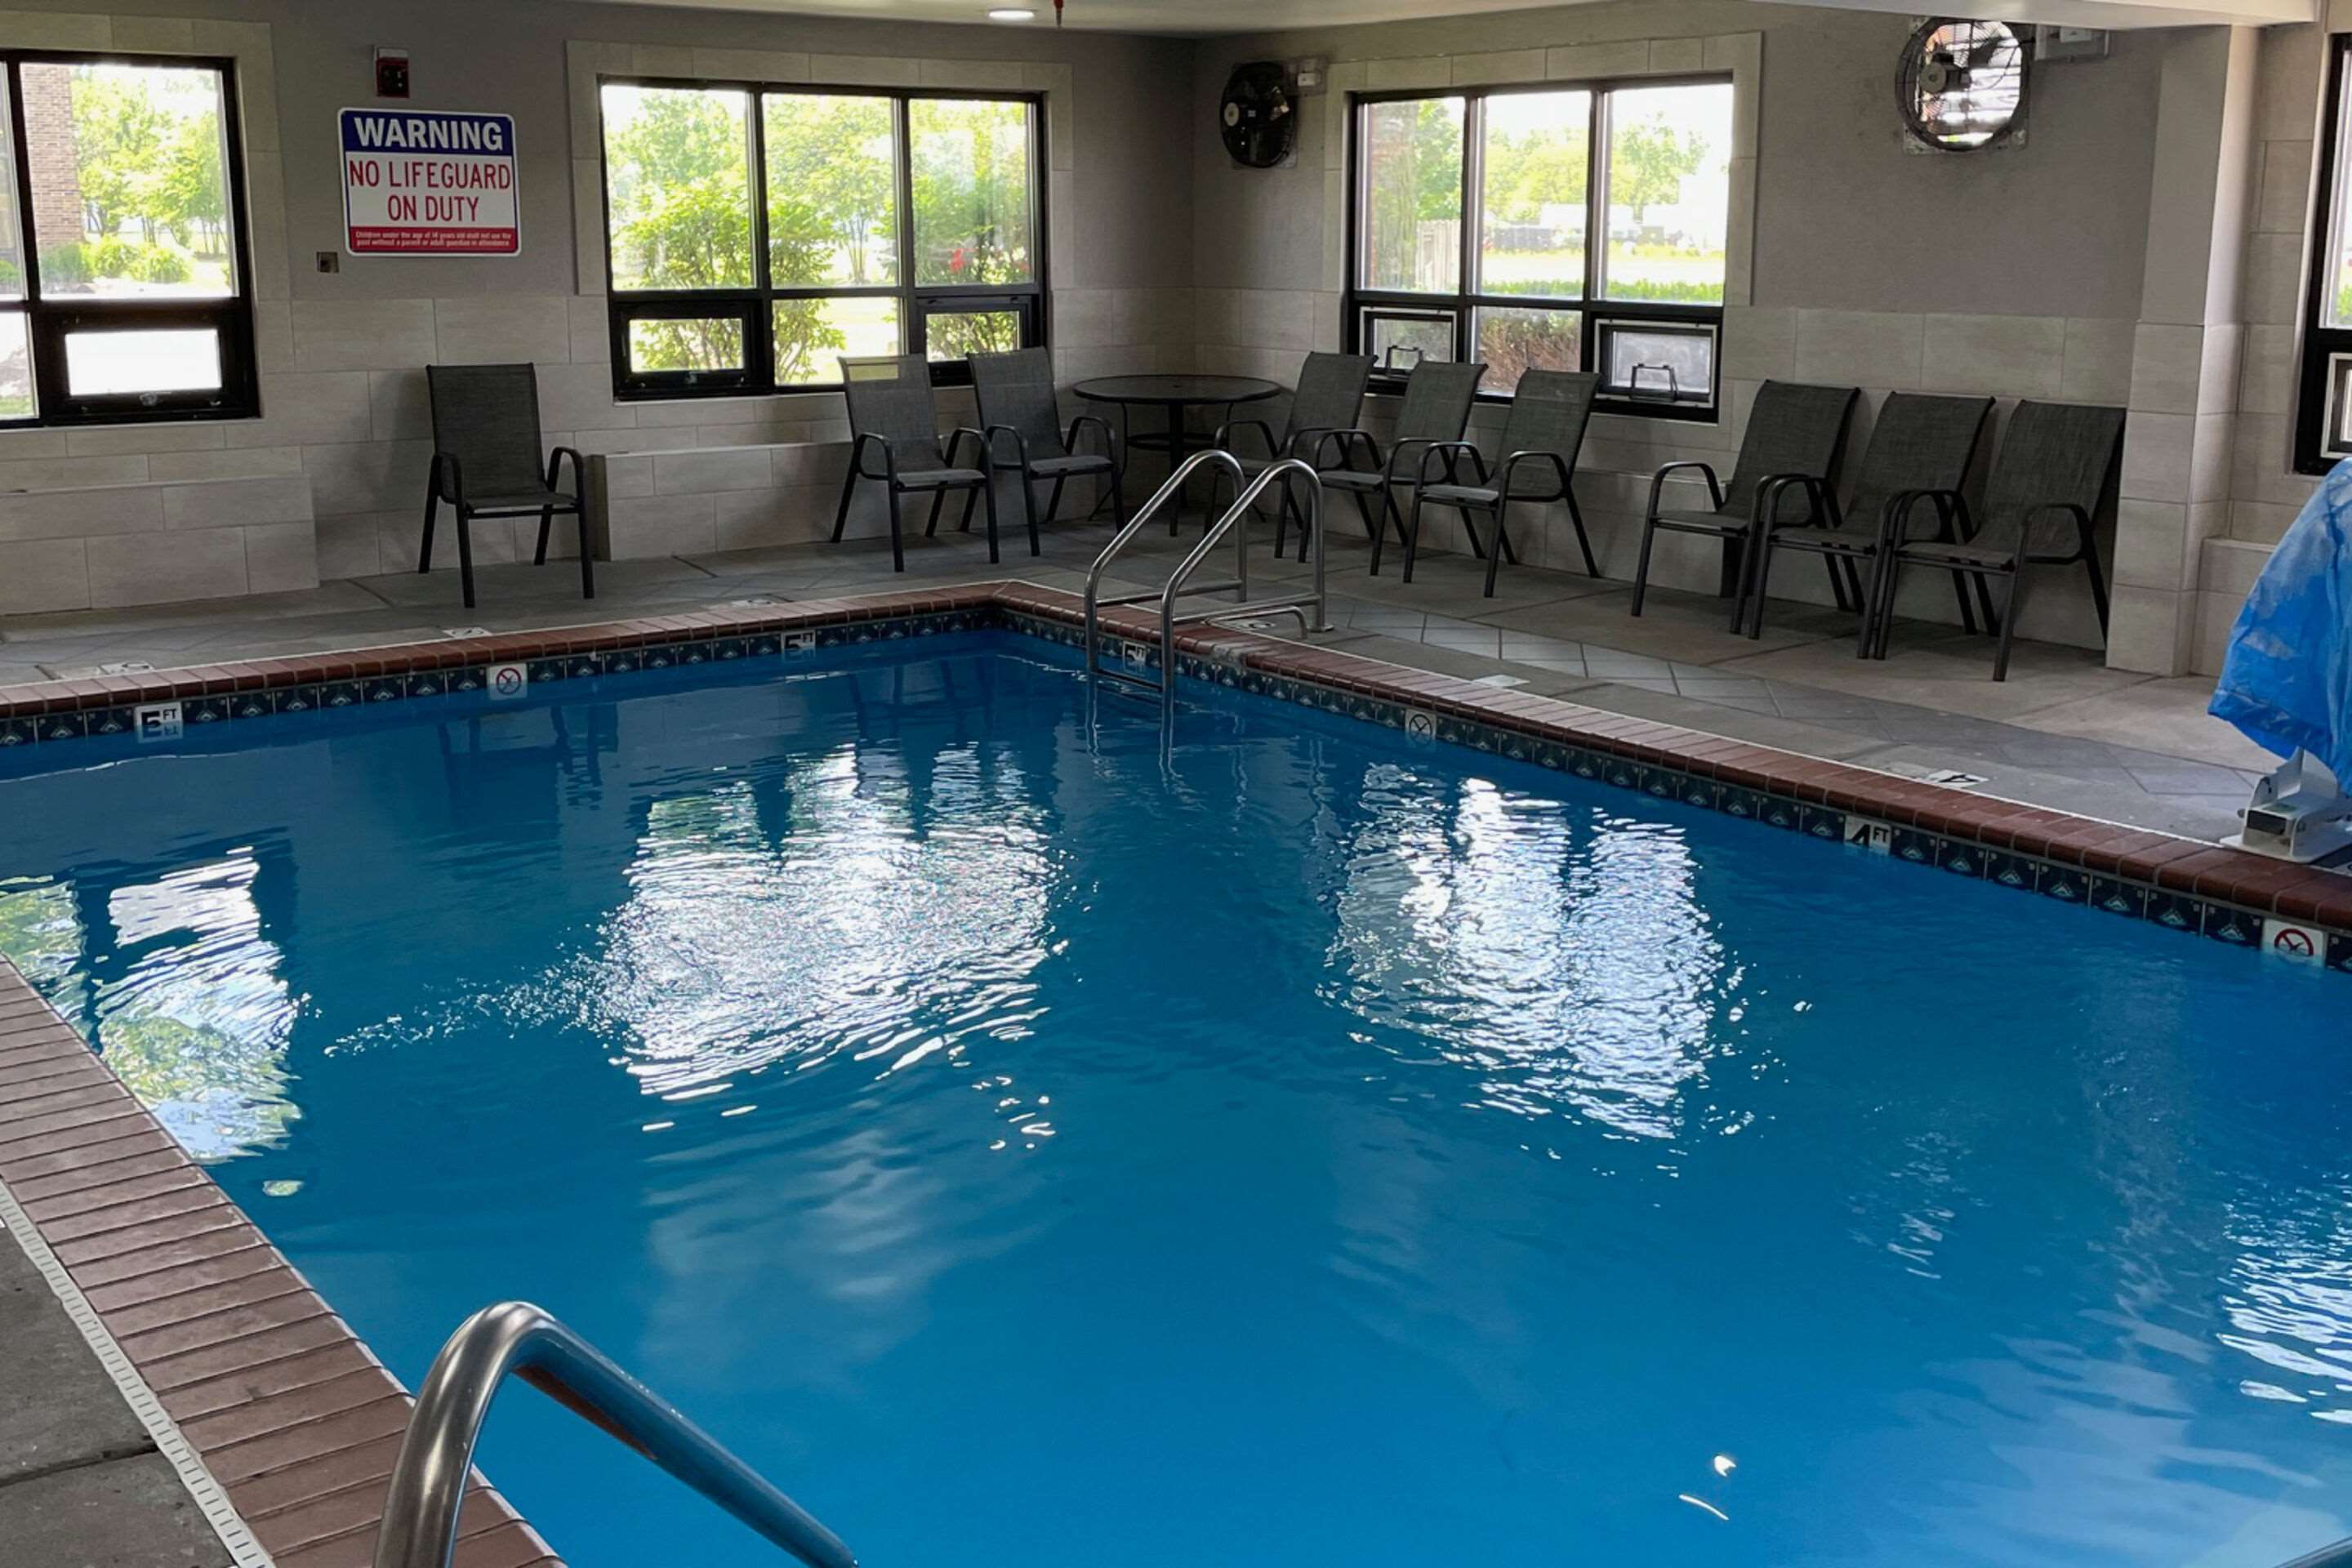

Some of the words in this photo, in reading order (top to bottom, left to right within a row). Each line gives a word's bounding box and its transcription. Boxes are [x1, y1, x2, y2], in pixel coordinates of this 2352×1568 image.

[354, 117, 503, 151] WARNING
[350, 160, 380, 188] NO
[389, 161, 511, 190] LIFEGUARD
[387, 195, 417, 221] ON
[425, 196, 480, 222] DUTY
[1873, 826, 1889, 844] FT
